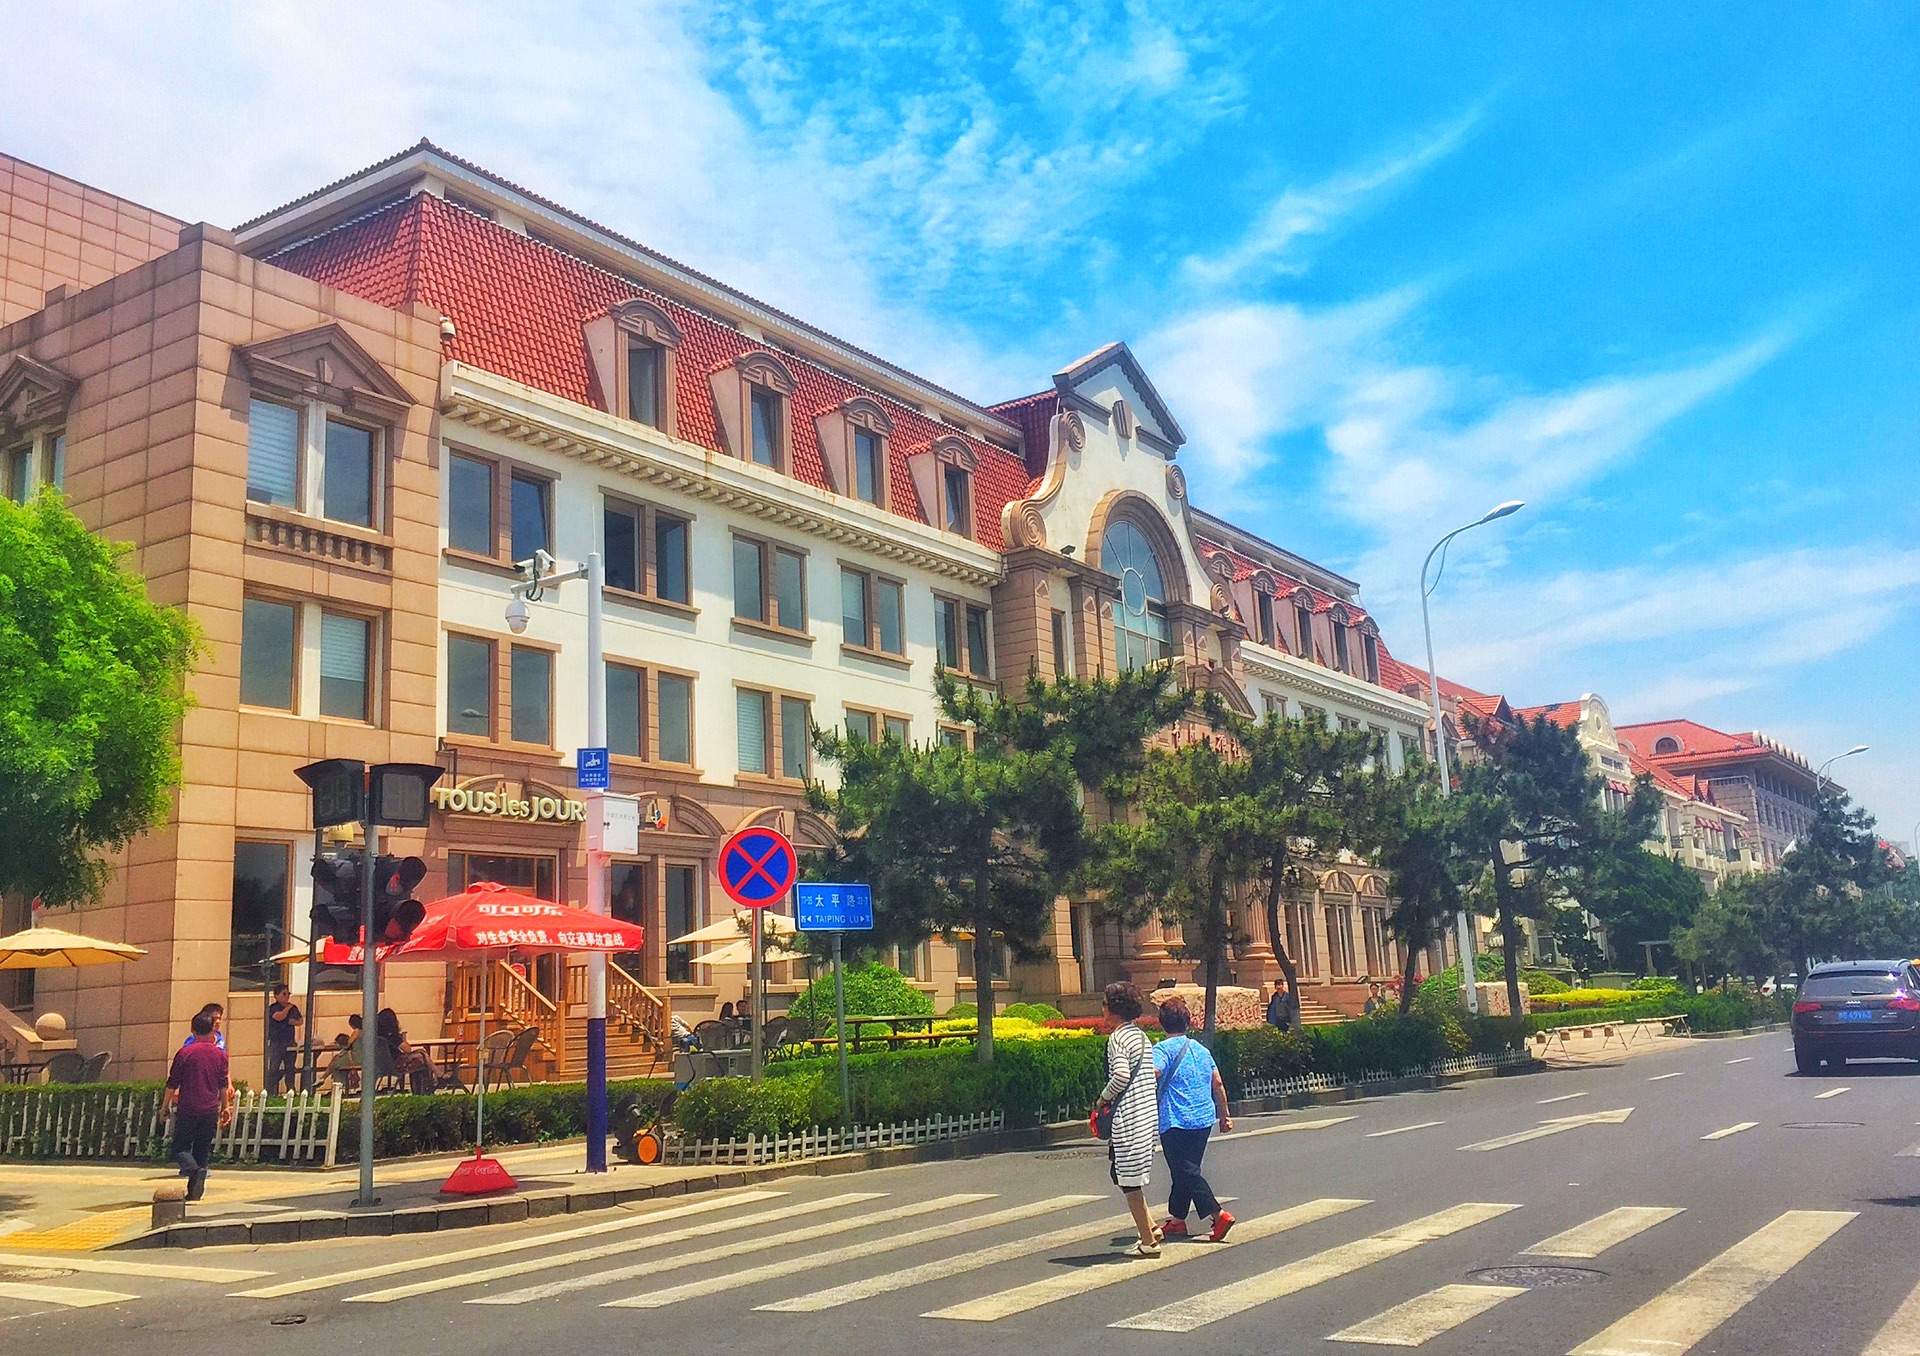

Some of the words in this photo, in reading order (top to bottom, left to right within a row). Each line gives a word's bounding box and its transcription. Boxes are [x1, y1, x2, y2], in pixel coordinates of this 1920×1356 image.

[435, 787, 498, 813] TOUS
[499, 792, 530, 817] les
[815, 893, 856, 908] 太平路
[476, 904, 568, 917] 可口可乐
[815, 915, 846, 923] TAIPING
[849, 915, 859, 923] LU
